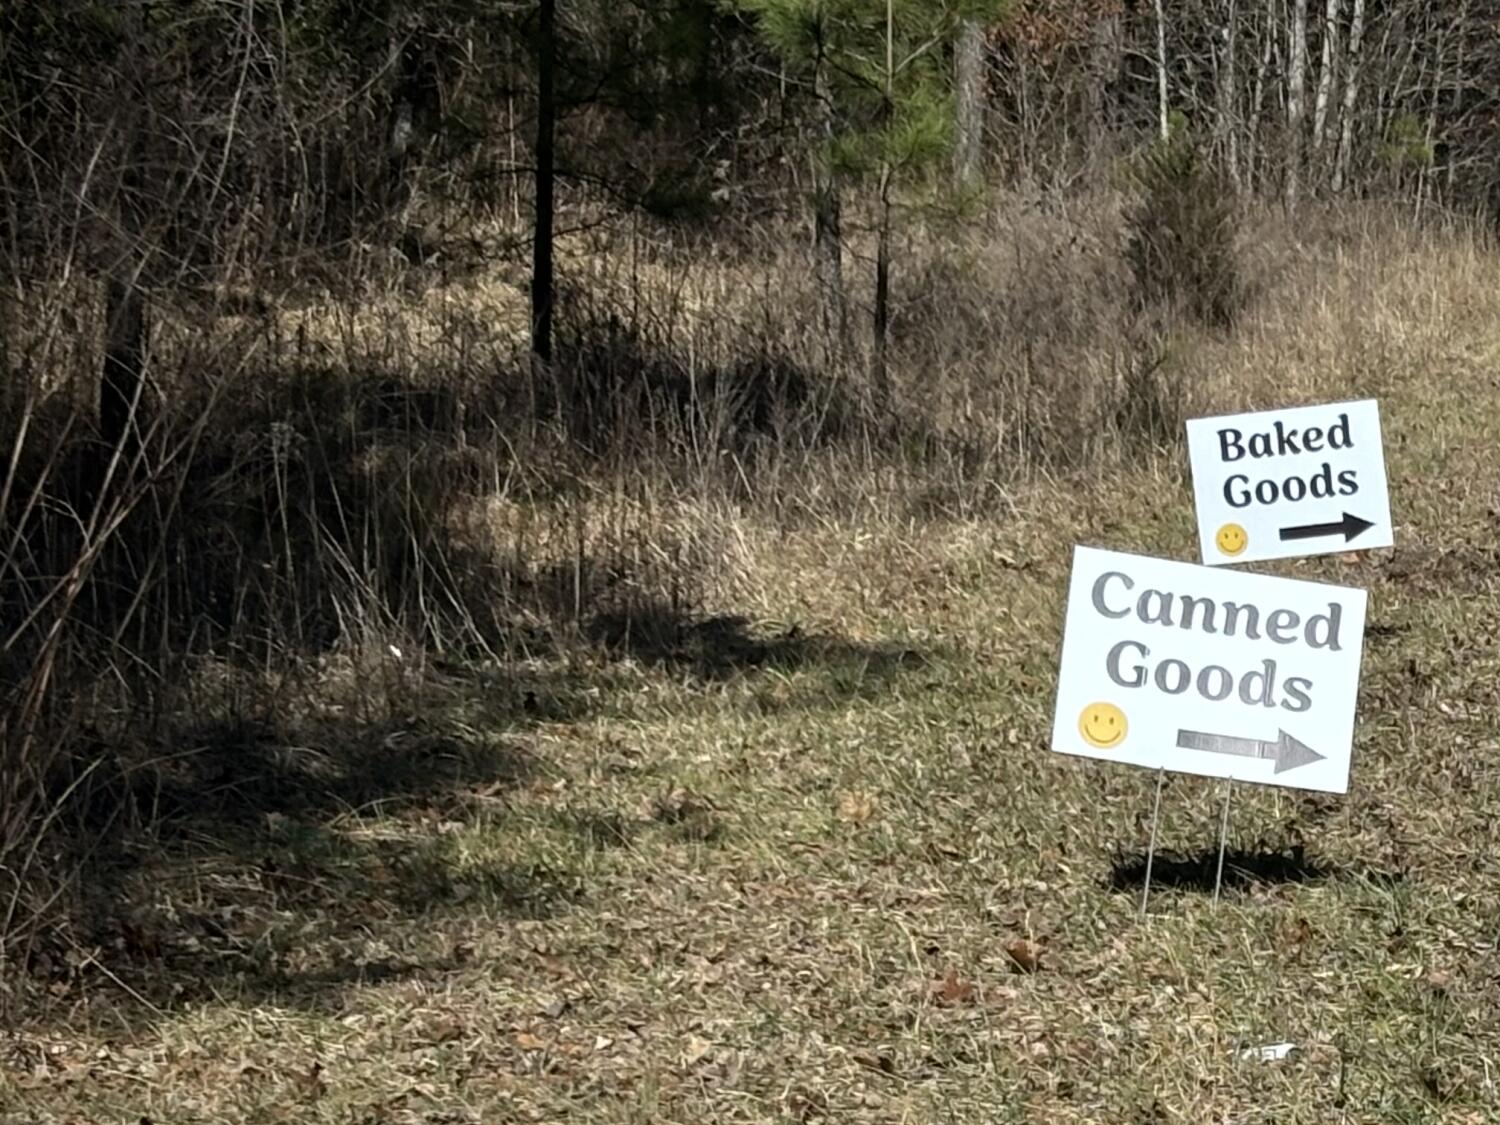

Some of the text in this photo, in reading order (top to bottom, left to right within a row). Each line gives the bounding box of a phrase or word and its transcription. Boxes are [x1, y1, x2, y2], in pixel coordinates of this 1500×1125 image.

[1216, 413, 1355, 463] Baked
[1223, 462, 1360, 509] Goods
[1091, 571, 1344, 652] Canned
[1105, 639, 1314, 713] Goods
